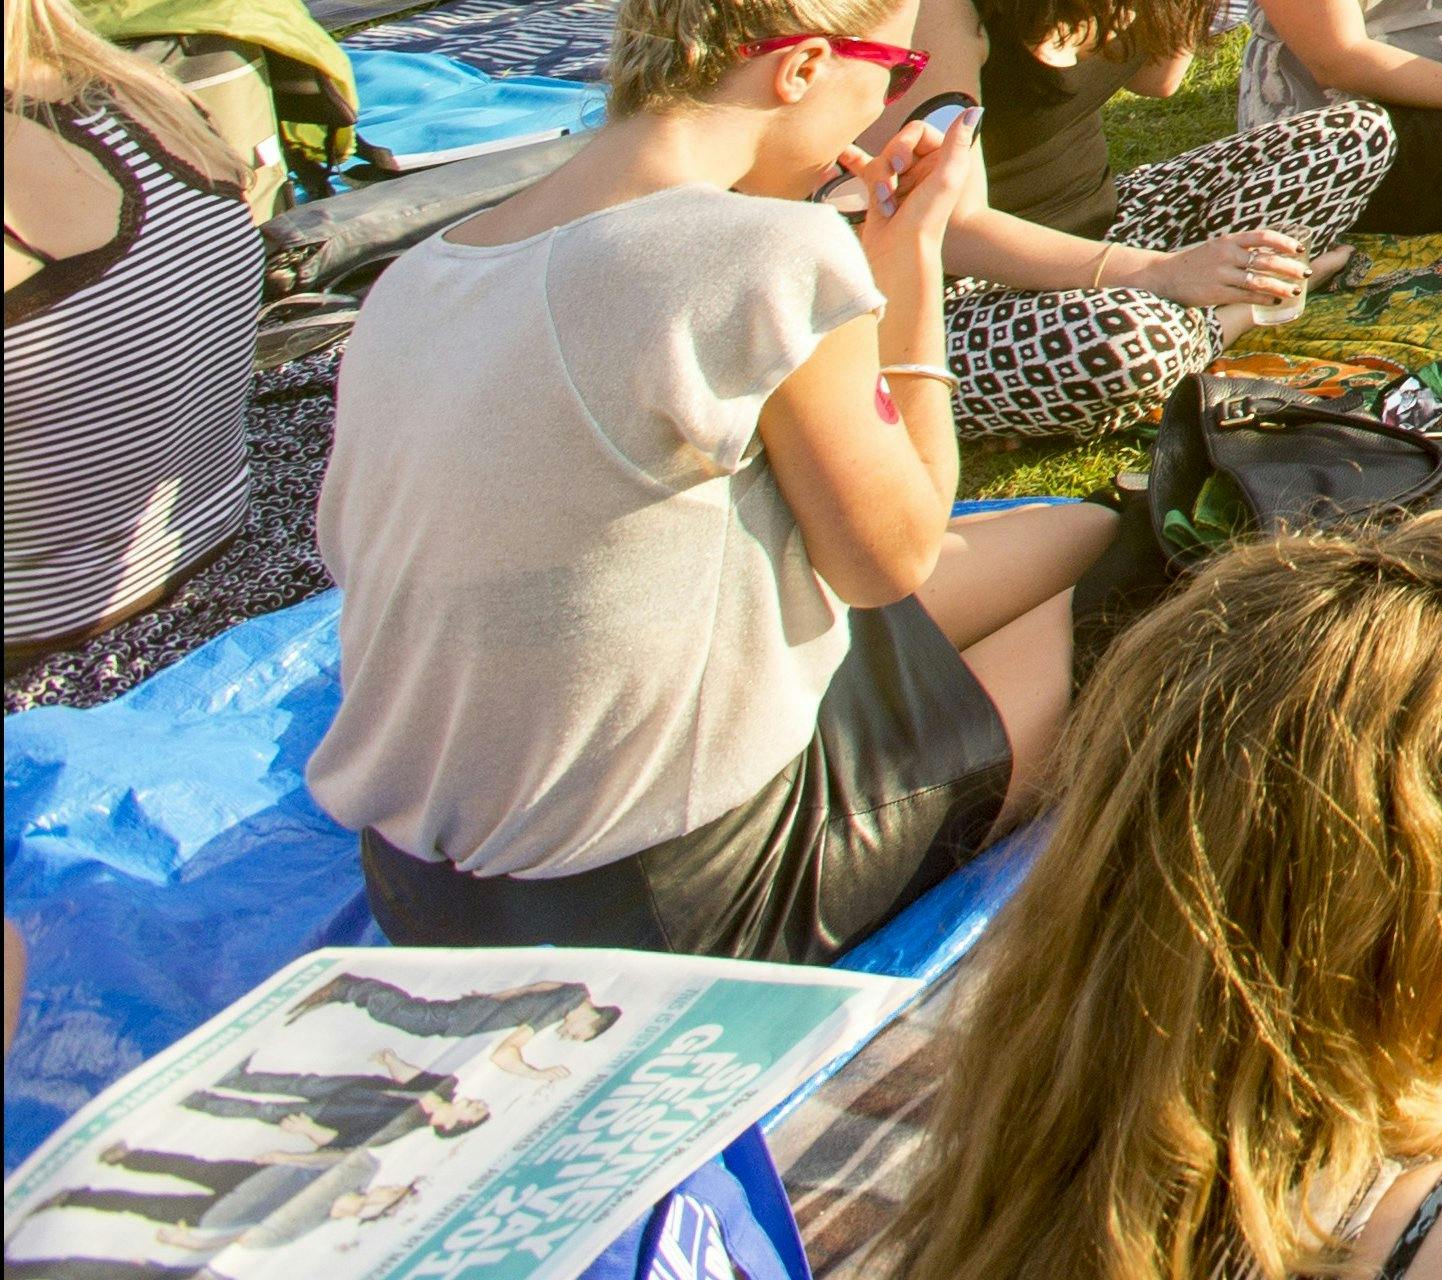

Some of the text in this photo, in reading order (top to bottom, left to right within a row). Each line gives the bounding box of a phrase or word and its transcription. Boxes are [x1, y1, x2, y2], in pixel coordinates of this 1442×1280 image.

[400, 1028, 725, 1279] GUIDE 201
[441, 1054, 739, 1279] FESTIVAL
[513, 1065, 759, 1261] SYDNEY
